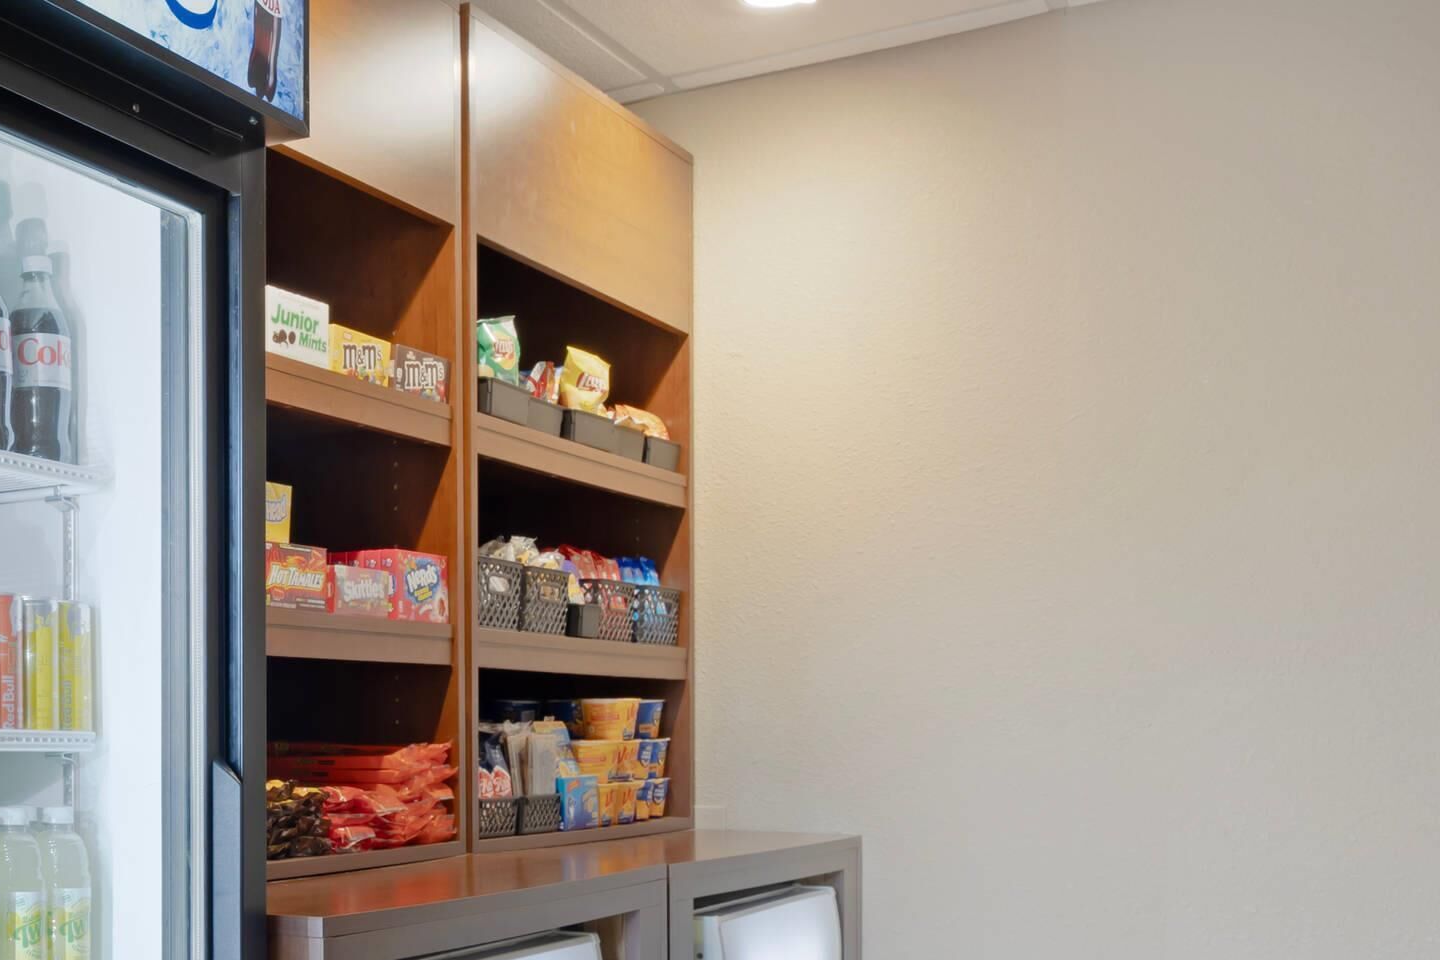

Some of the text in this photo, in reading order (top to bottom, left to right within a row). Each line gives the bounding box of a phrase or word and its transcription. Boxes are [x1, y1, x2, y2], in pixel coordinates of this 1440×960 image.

[271, 303, 320, 334] Junior
[298, 331, 327, 353] Mints
[2, 674, 15, 702] Bull
